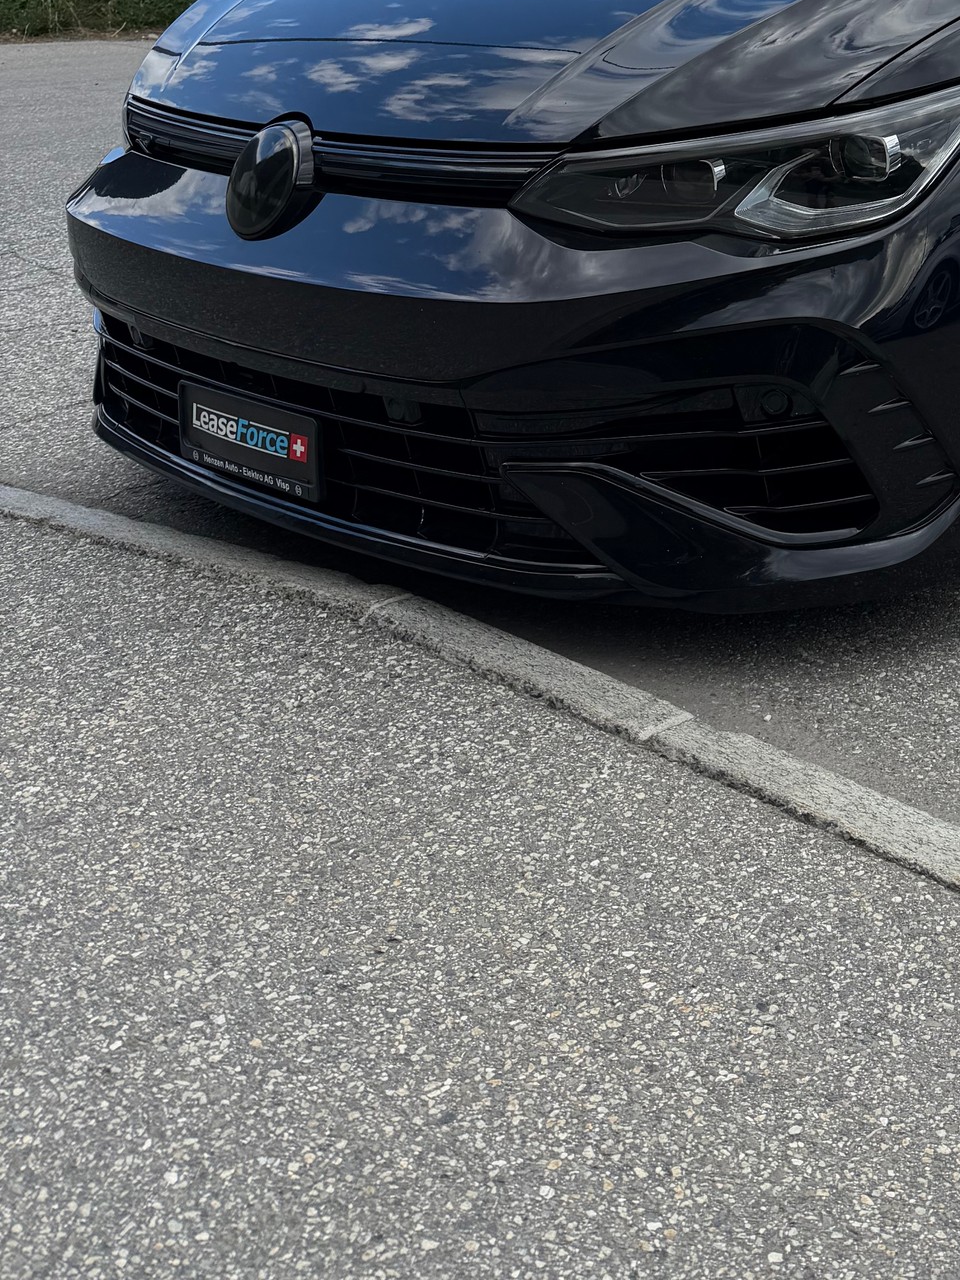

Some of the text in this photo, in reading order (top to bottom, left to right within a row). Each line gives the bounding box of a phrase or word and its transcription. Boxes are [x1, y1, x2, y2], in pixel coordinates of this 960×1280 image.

[192, 402, 289, 455] LeaseForce
[225, 461, 239, 473] Auto
[264, 474, 274, 486] AG
[276, 477, 290, 492] Visp
